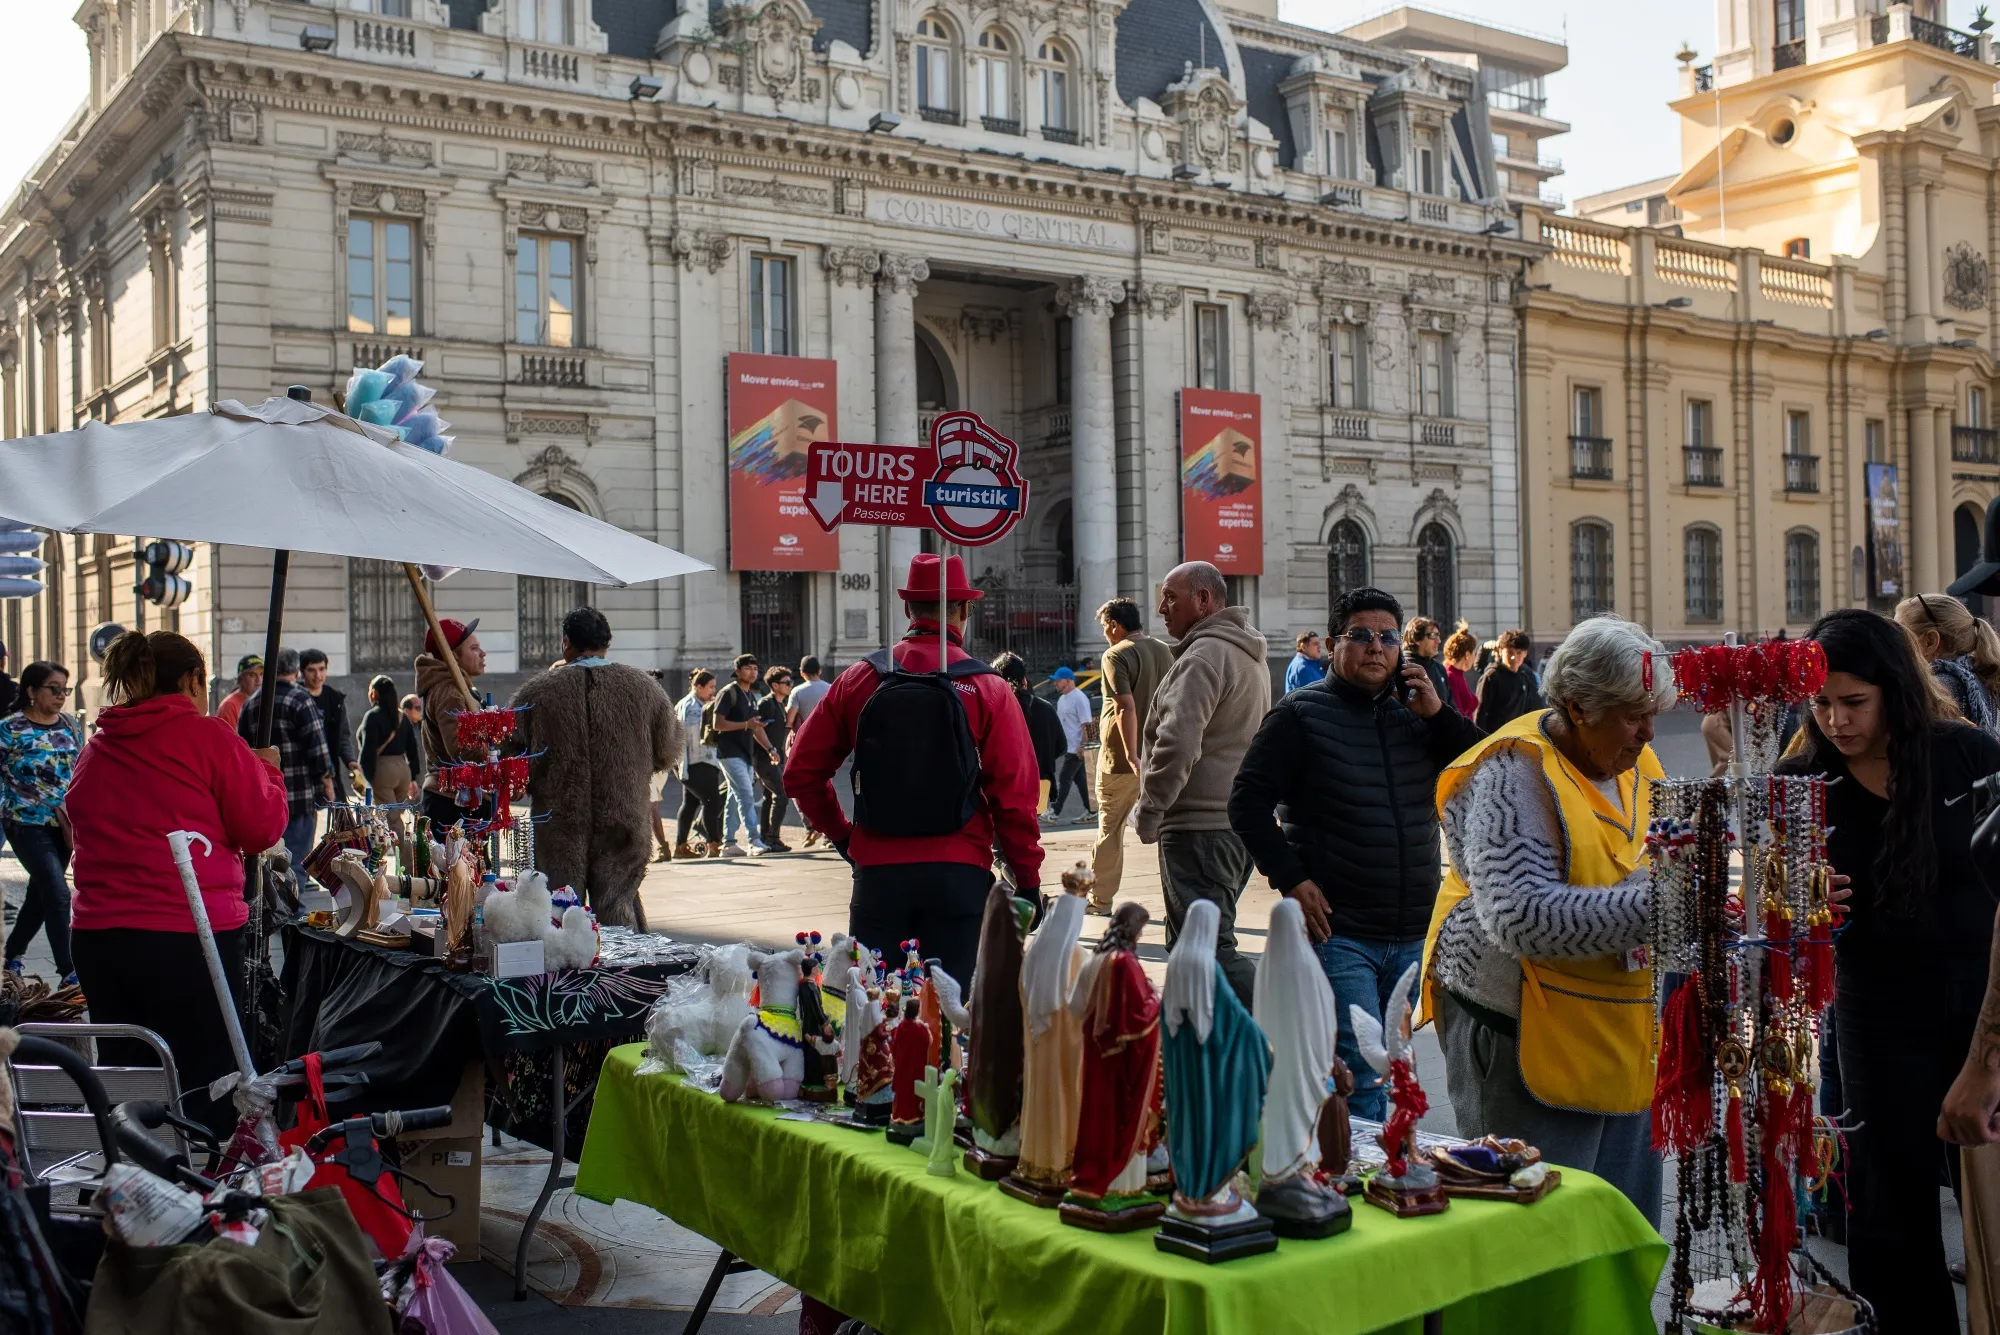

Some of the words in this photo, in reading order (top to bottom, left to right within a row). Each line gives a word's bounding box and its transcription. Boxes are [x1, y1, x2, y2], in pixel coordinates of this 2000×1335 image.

[885, 196, 991, 233] CORREO
[1001, 212, 1117, 248] CENTRAL
[741, 374, 769, 385] Mover
[1190, 406, 1211, 416] Mover
[816, 449, 915, 481] TOURS
[779, 495, 804, 503] mano
[855, 483, 909, 505] HERE
[935, 486, 1008, 506] turistik
[779, 505, 809, 517] exper
[853, 507, 905, 522] Passeios
[1219, 518, 1254, 529] expertos
[841, 573, 871, 591] 989
[951, 680, 977, 693] ristik
